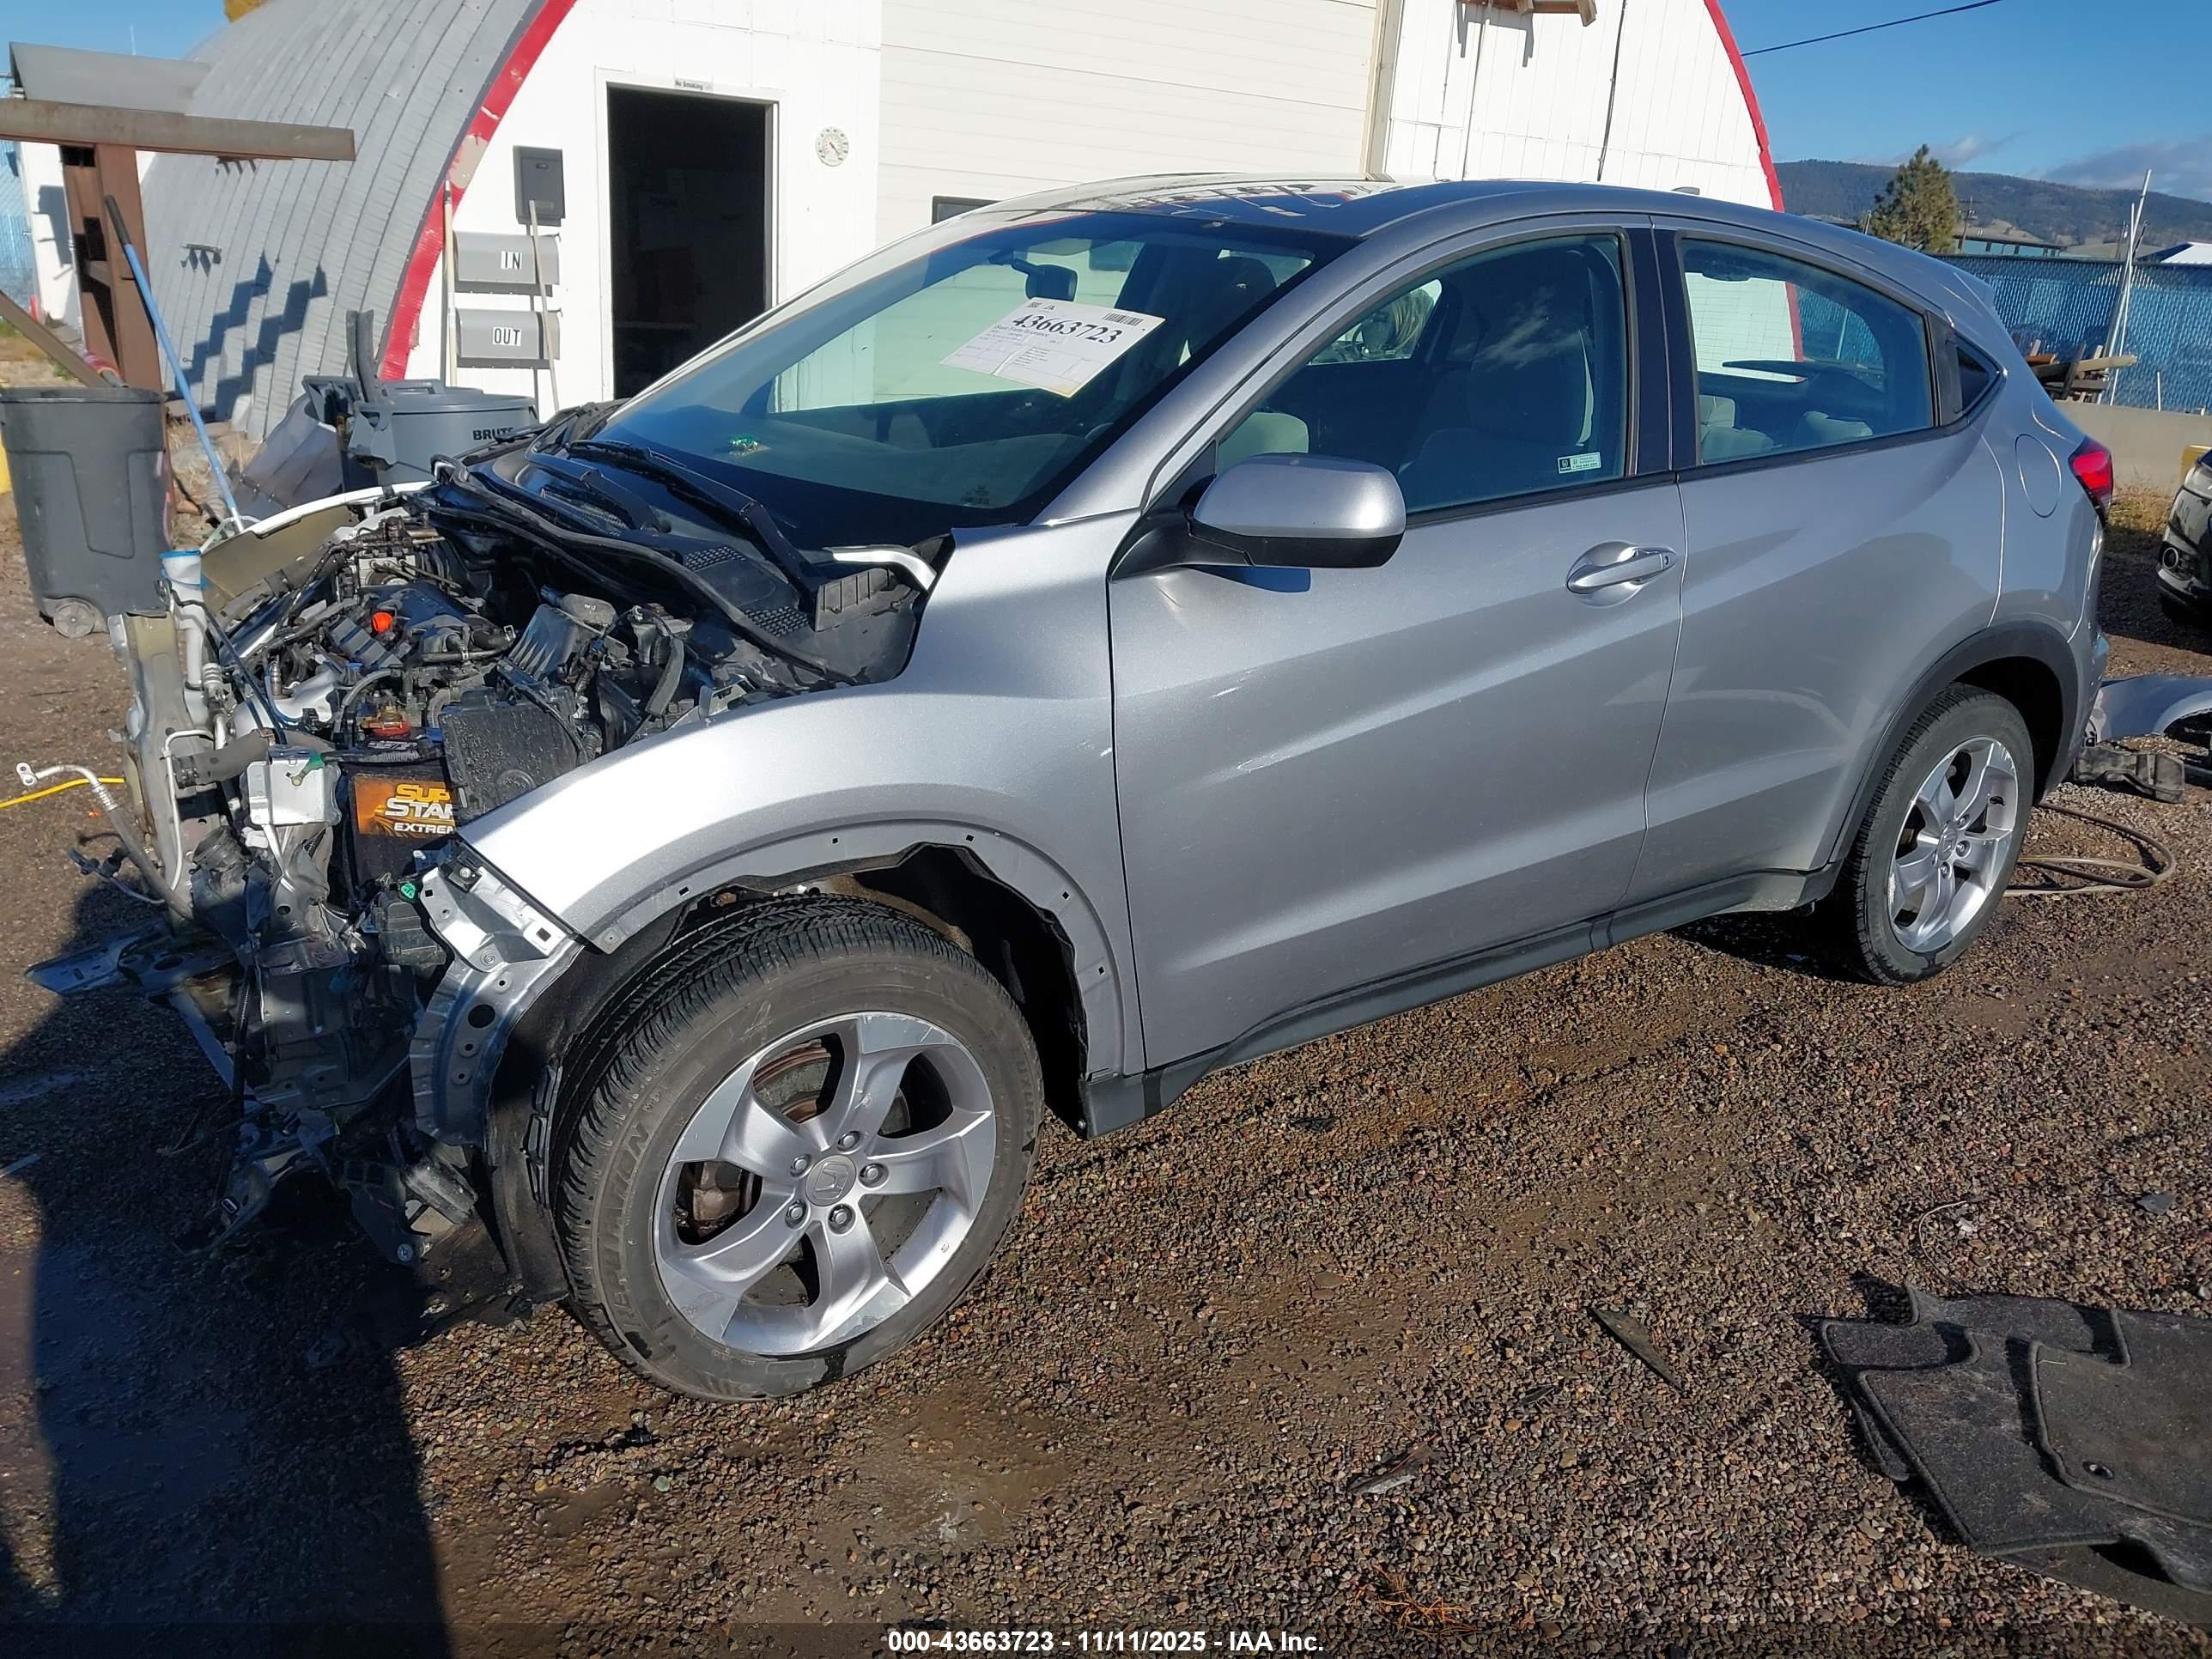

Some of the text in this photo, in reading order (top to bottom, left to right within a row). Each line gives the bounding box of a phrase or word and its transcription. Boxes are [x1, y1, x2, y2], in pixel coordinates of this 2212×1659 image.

[504, 251, 521, 270] IN
[494, 327, 520, 345] OUT
[1012, 313, 1123, 343] 43663723
[396, 784, 451, 803] SUP
[384, 797, 453, 819] STA
[393, 822, 454, 835] EXTRE
